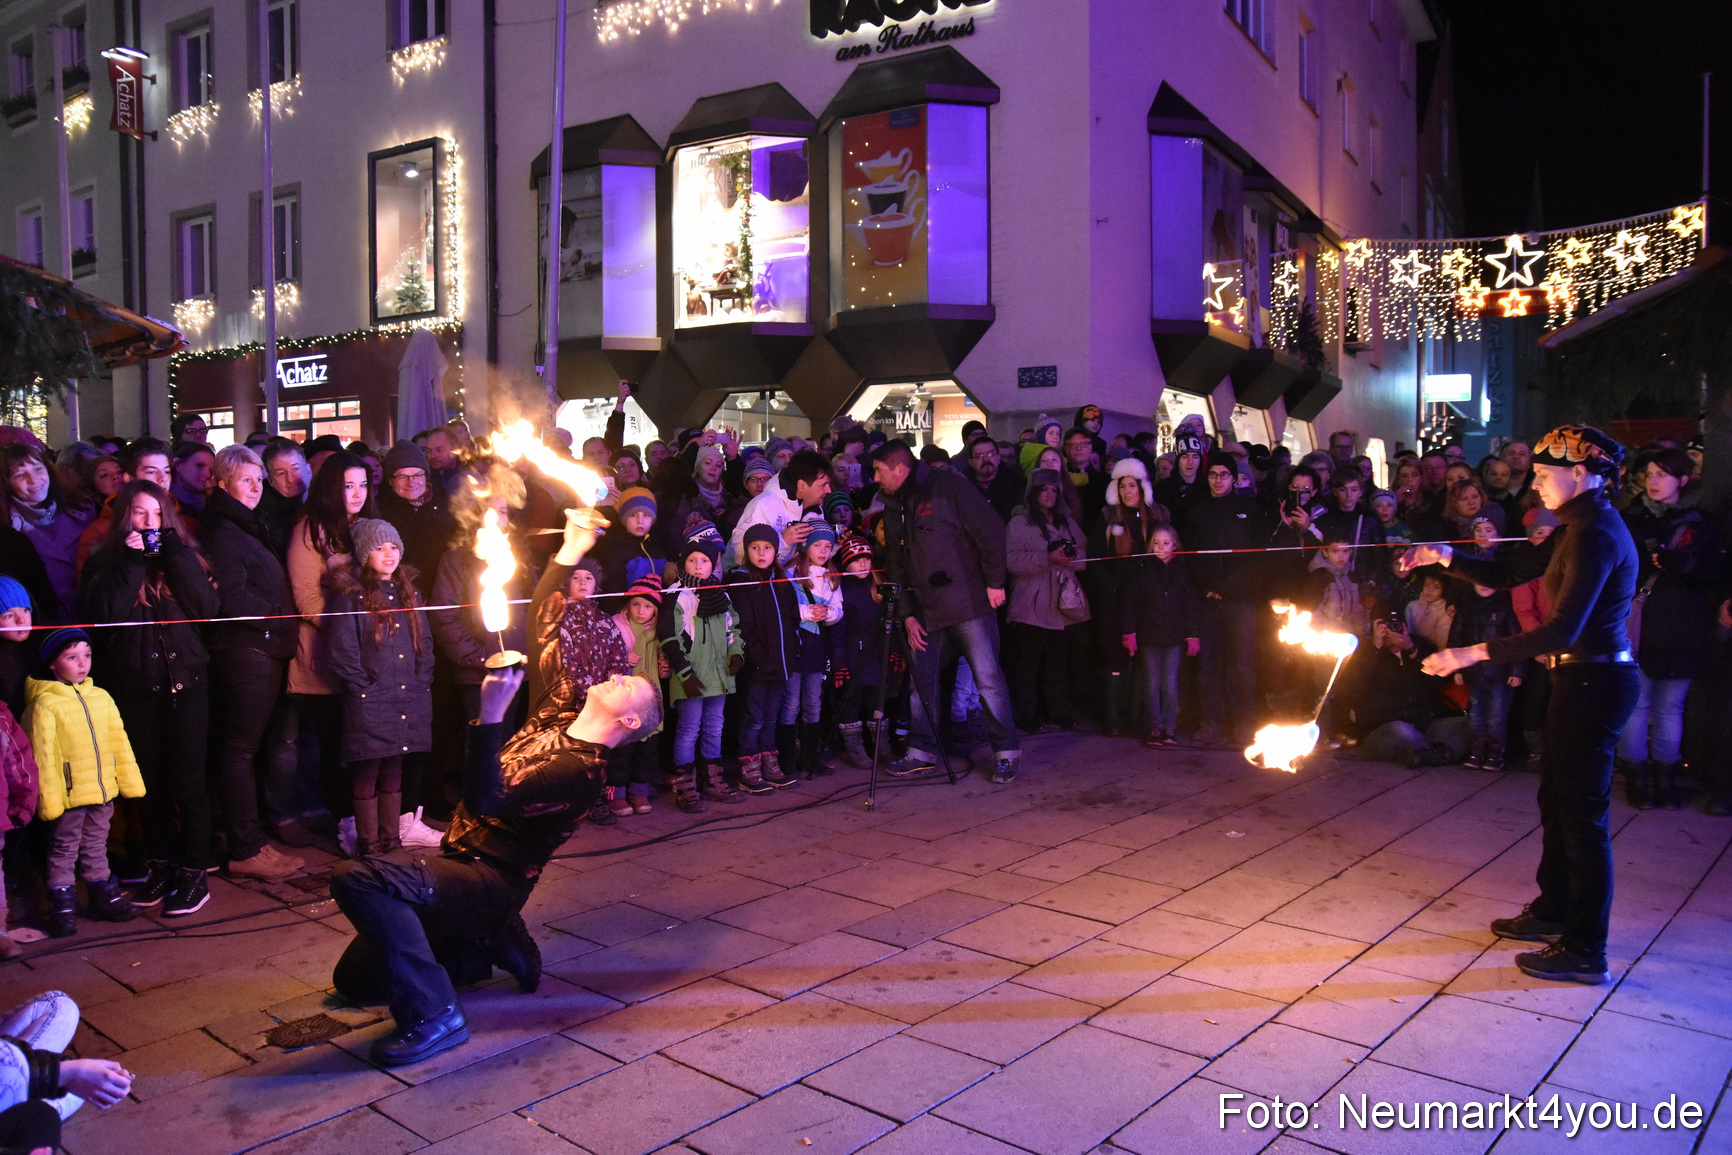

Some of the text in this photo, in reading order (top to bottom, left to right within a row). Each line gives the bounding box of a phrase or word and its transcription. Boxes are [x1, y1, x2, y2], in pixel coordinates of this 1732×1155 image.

[835, 43, 872, 61] am
[876, 17, 975, 53] Rathaus
[115, 64, 137, 130] Achatz
[276, 357, 328, 386] Achatz
[895, 410, 932, 430] RACKL
